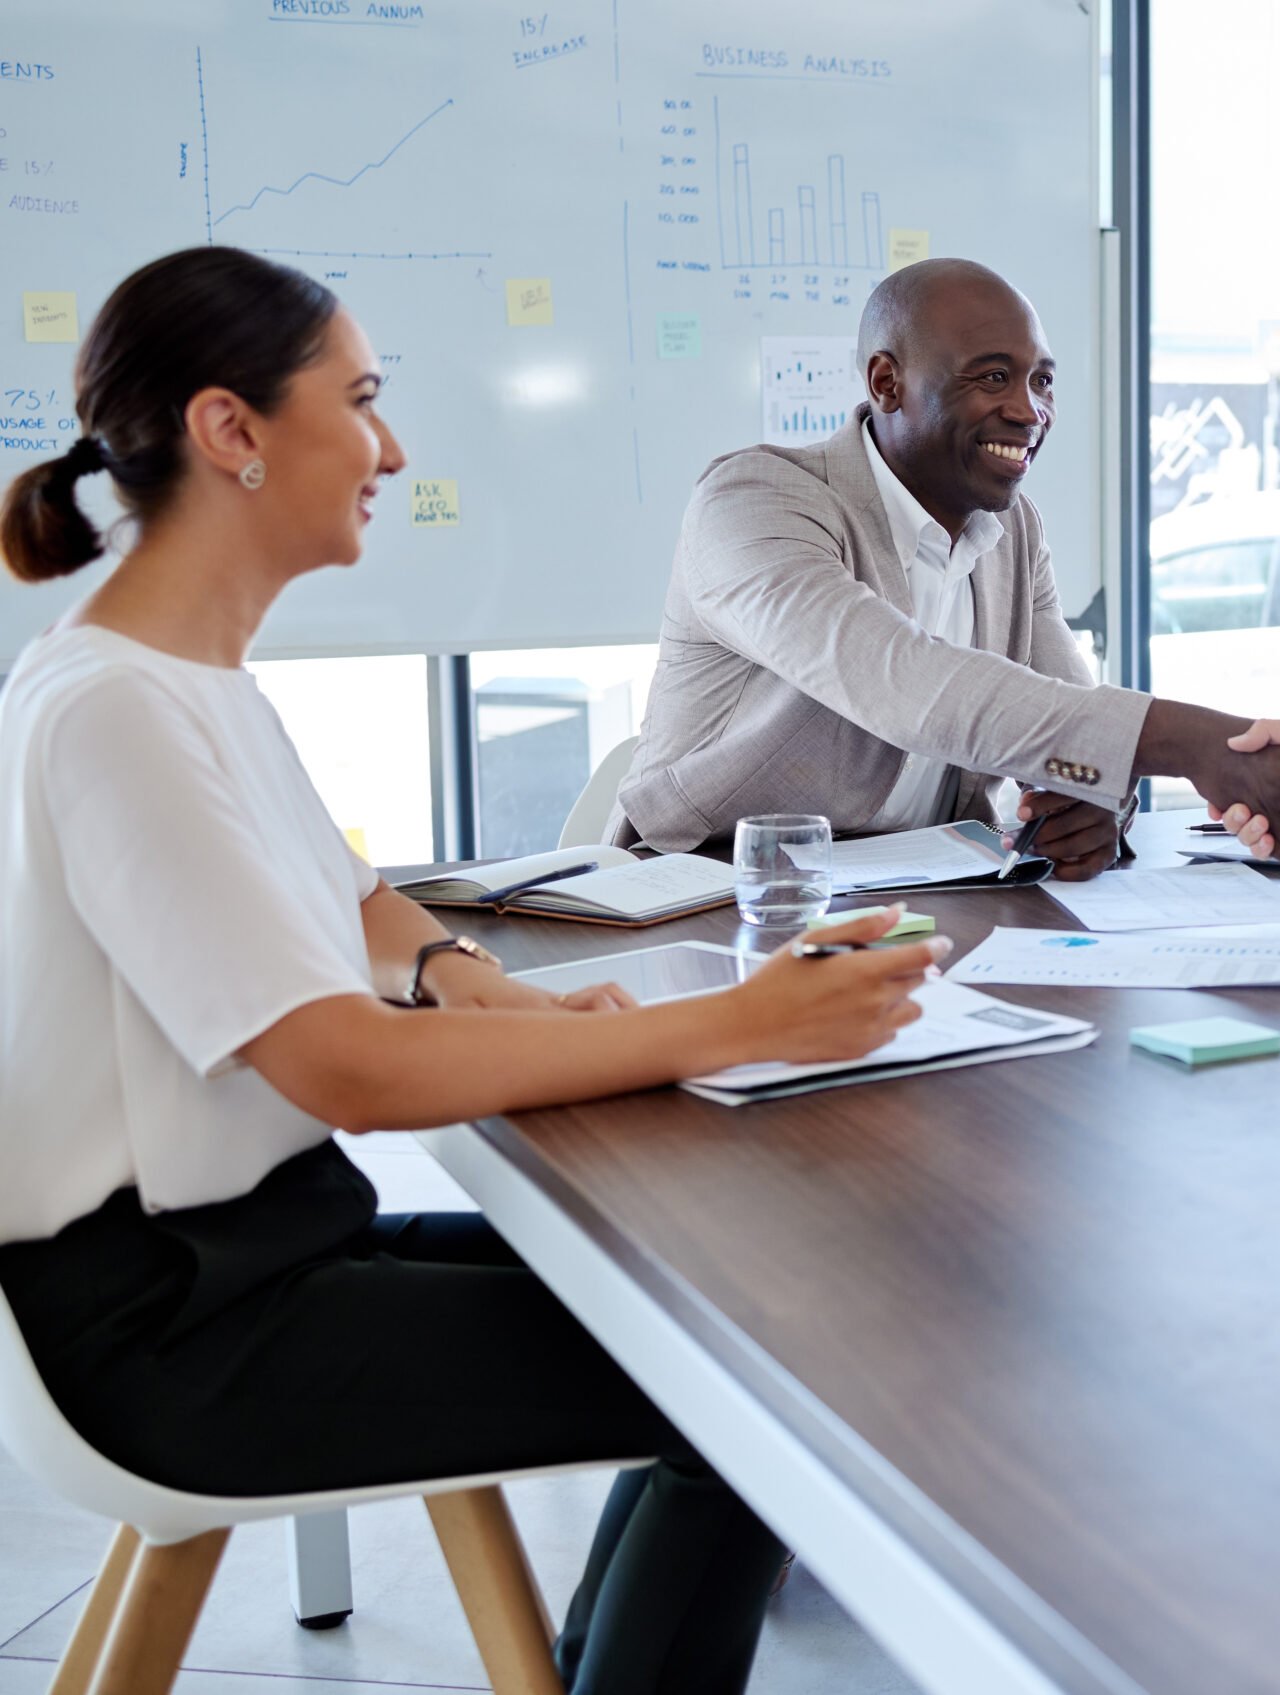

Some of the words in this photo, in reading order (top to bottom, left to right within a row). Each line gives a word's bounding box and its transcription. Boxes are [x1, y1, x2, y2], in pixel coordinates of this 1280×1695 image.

[273, 0, 350, 16] PREVIOUS
[366, 3, 424, 19] ANNUM
[513, 35, 587, 64] INCREASE
[703, 44, 789, 69] BUSINESS
[803, 54, 892, 78] ANALYSIS
[9, 194, 80, 215] AUDIENCE
[5, 388, 59, 411] 75%
[0, 417, 47, 430] USAGE
[415, 482, 442, 498] ASK
[418, 499, 448, 513] CEO
